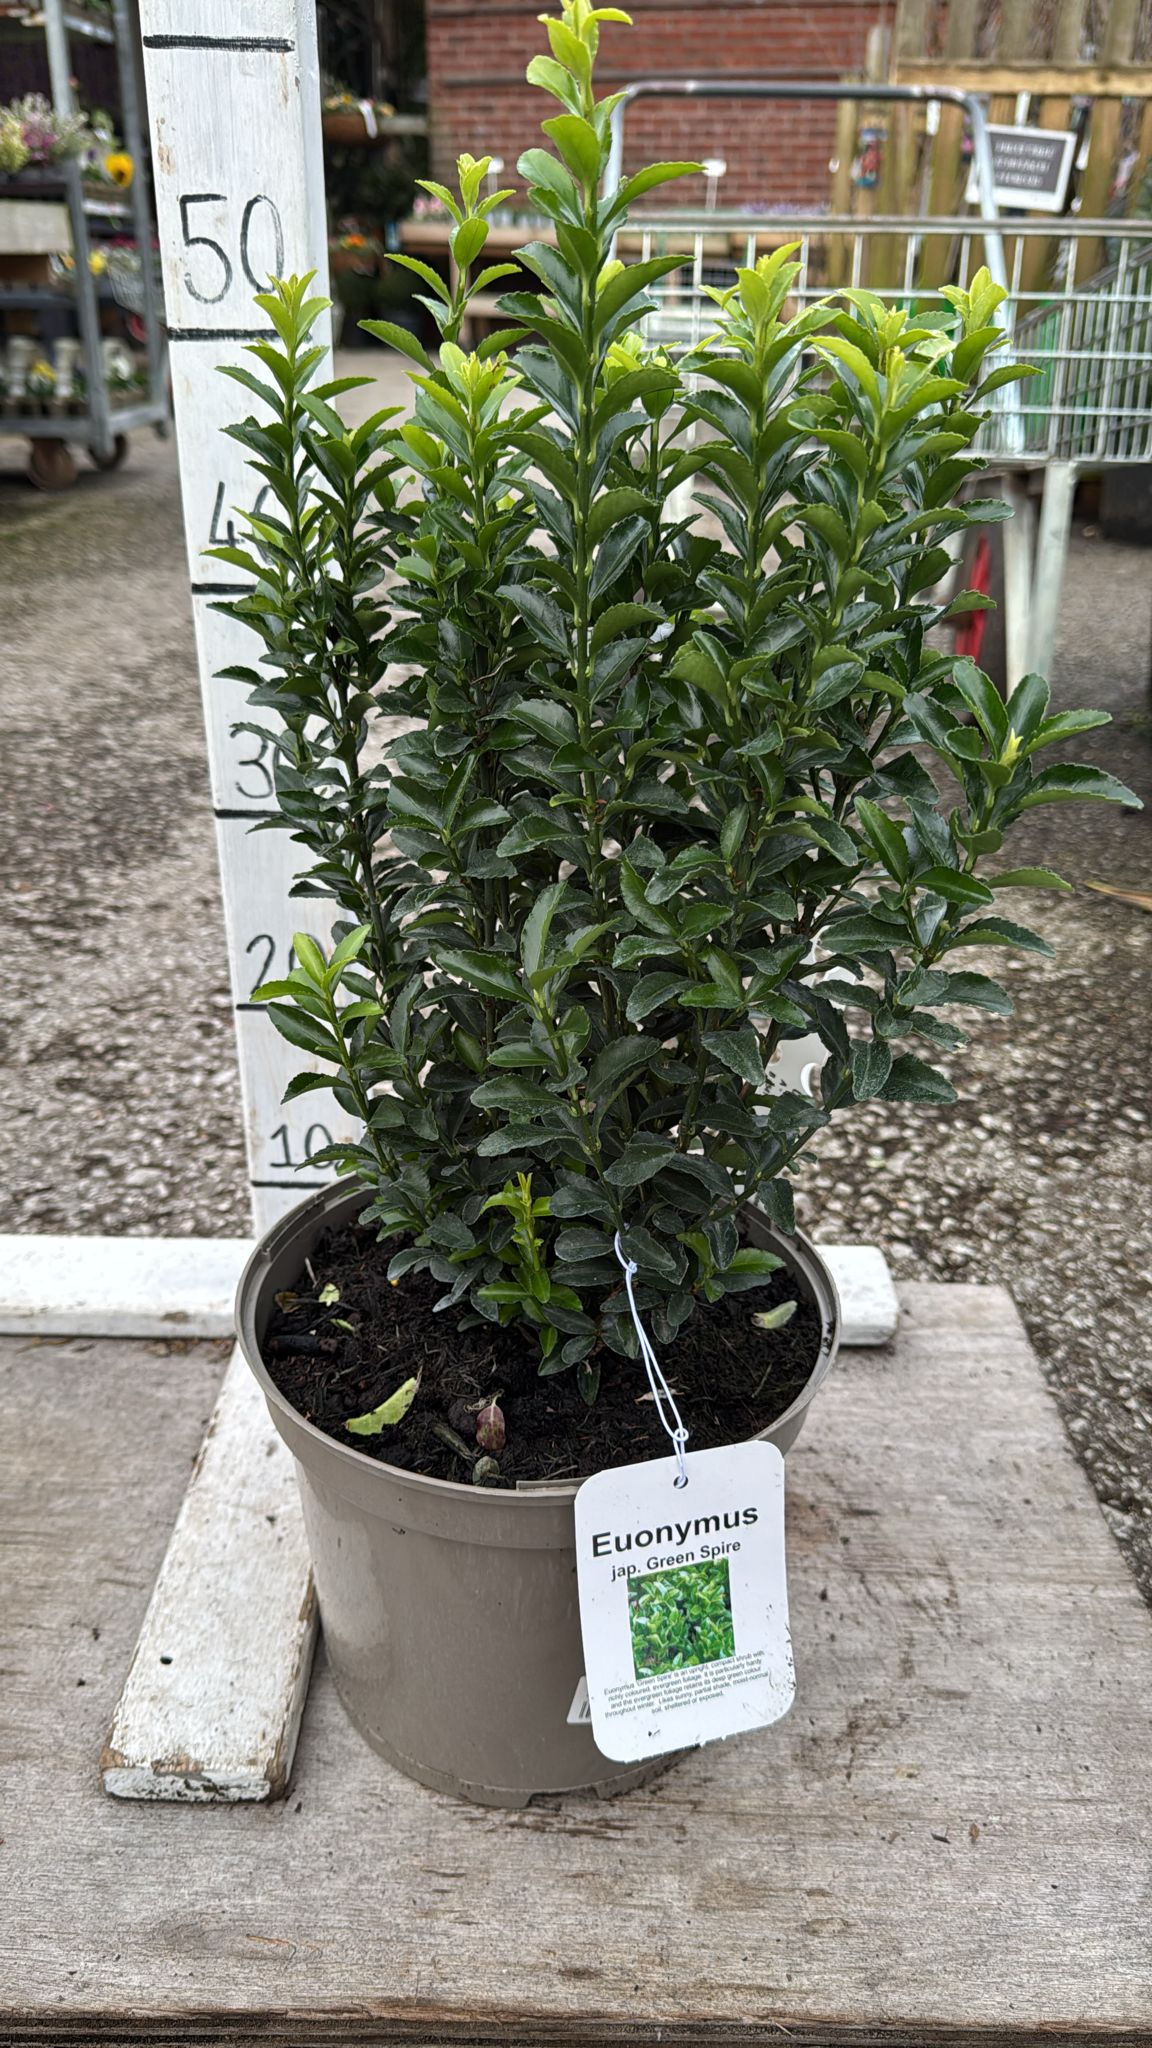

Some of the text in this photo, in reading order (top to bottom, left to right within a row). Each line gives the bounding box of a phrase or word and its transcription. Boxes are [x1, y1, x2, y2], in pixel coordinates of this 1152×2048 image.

[180, 193, 284, 304] 50
[230, 728, 280, 799] 3
[271, 1124, 334, 1169] 10
[592, 1507, 759, 1557] Euonymus
[611, 1541, 741, 1582] jap. Green Spire
[604, 1682, 635, 1696] Euonymus
[711, 1658, 735, 1668] compact
[736, 1653, 752, 1662] shrub
[753, 1650, 764, 1658] with
[608, 1693, 624, 1703] richly
[652, 1679, 682, 1691] evergreen
[715, 1663, 745, 1675] particularly
[745, 1658, 762, 1667] hardy
[611, 1700, 622, 1709] and
[623, 1698, 632, 1706] the
[634, 1691, 663, 1703] evergreen
[663, 1686, 683, 1695] foliage
[683, 1681, 703, 1690] retains
[712, 1675, 726, 1684] deep
[727, 1670, 744, 1681] green
[744, 1666, 761, 1675] colour
[605, 1705, 636, 1718] throughout
[694, 1686, 712, 1696] partial
[664, 1699, 691, 1711] sheltered
